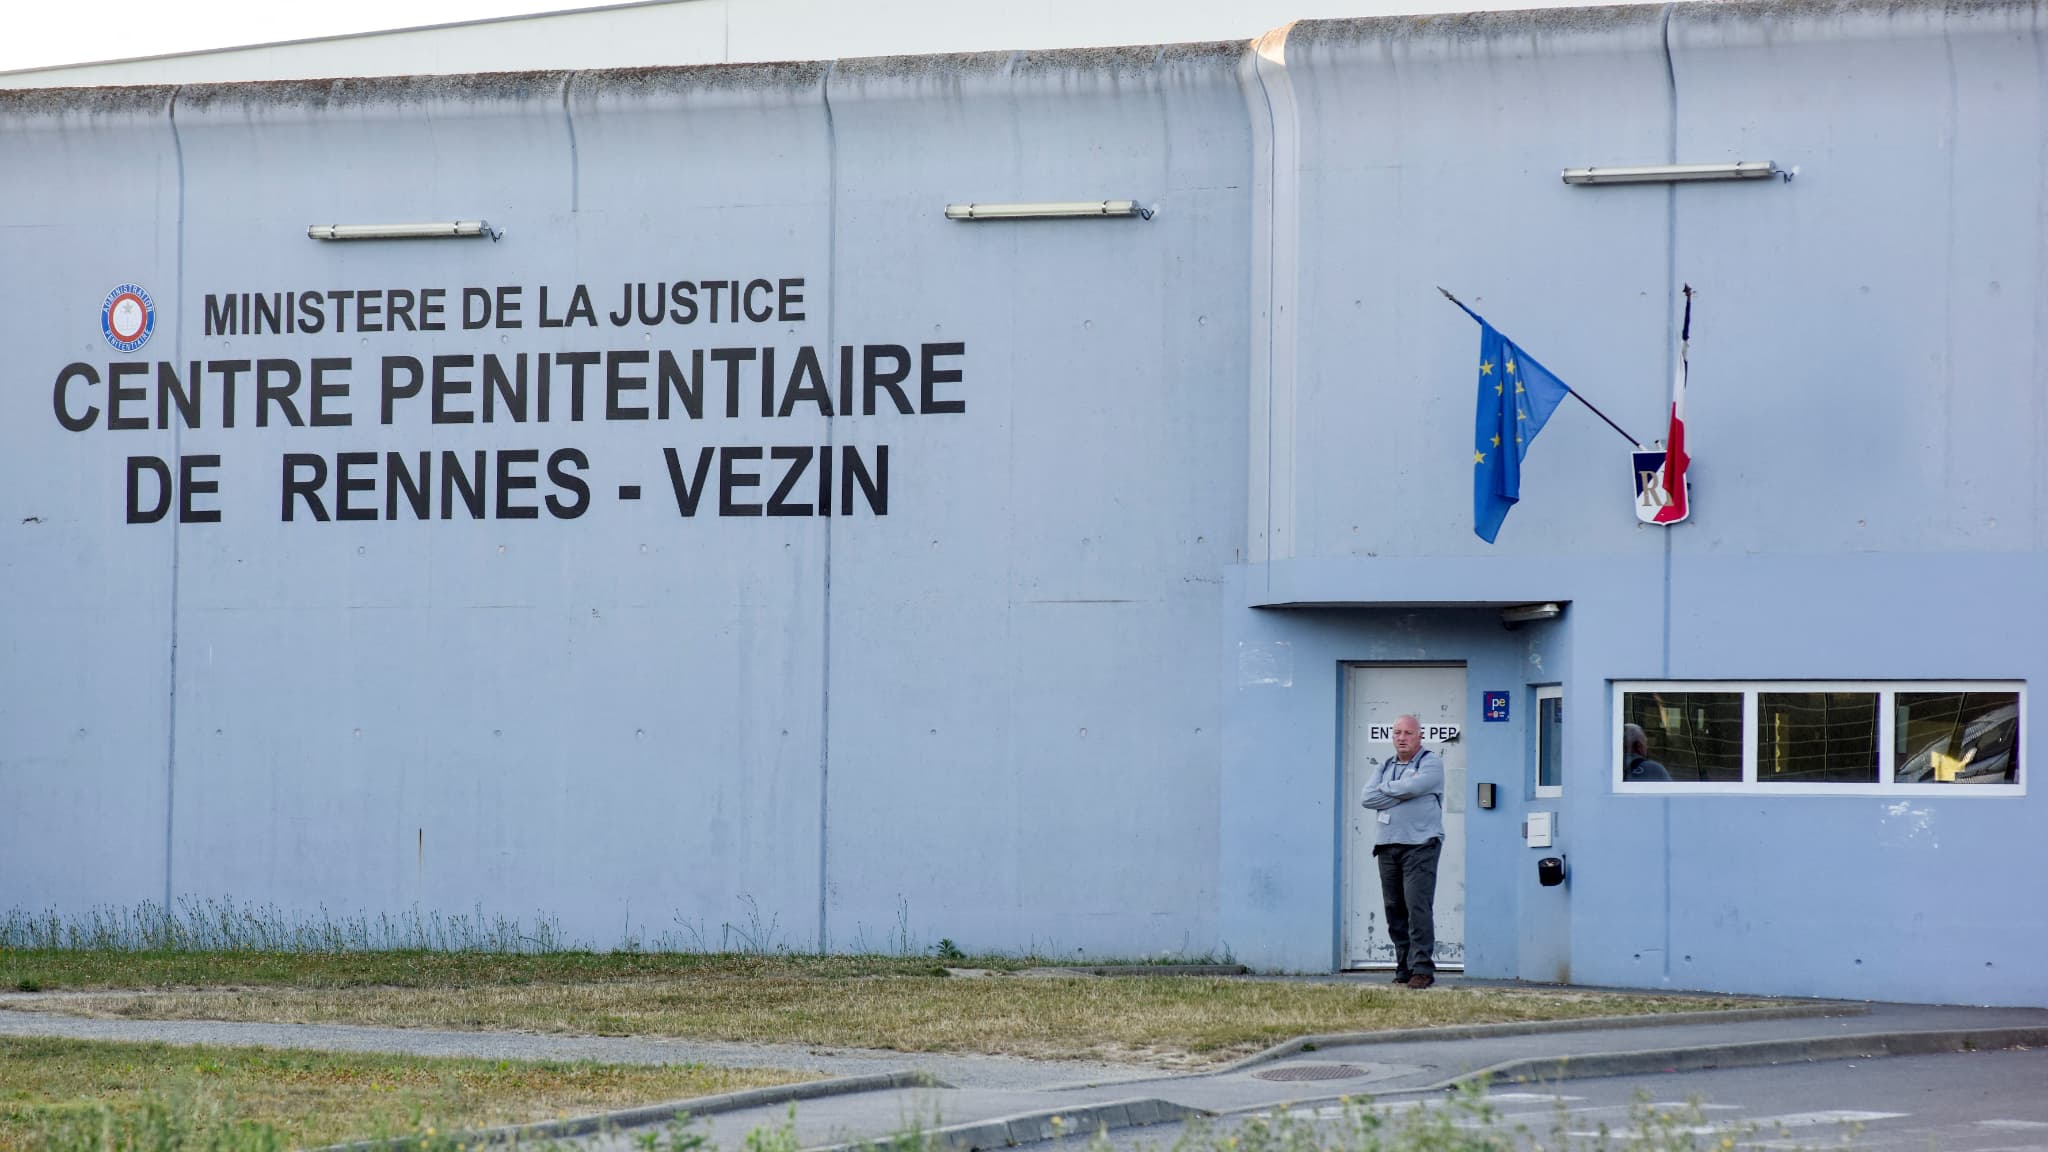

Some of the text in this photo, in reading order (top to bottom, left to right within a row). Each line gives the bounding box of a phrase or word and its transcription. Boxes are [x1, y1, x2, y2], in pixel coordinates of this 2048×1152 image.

[205, 278, 806, 336] MINISTERE DE LA JUSTICE
[53, 342, 966, 432] CENTRE PENITENTIAIRE
[126, 444, 889, 525] DE RENNES - VEZIN
